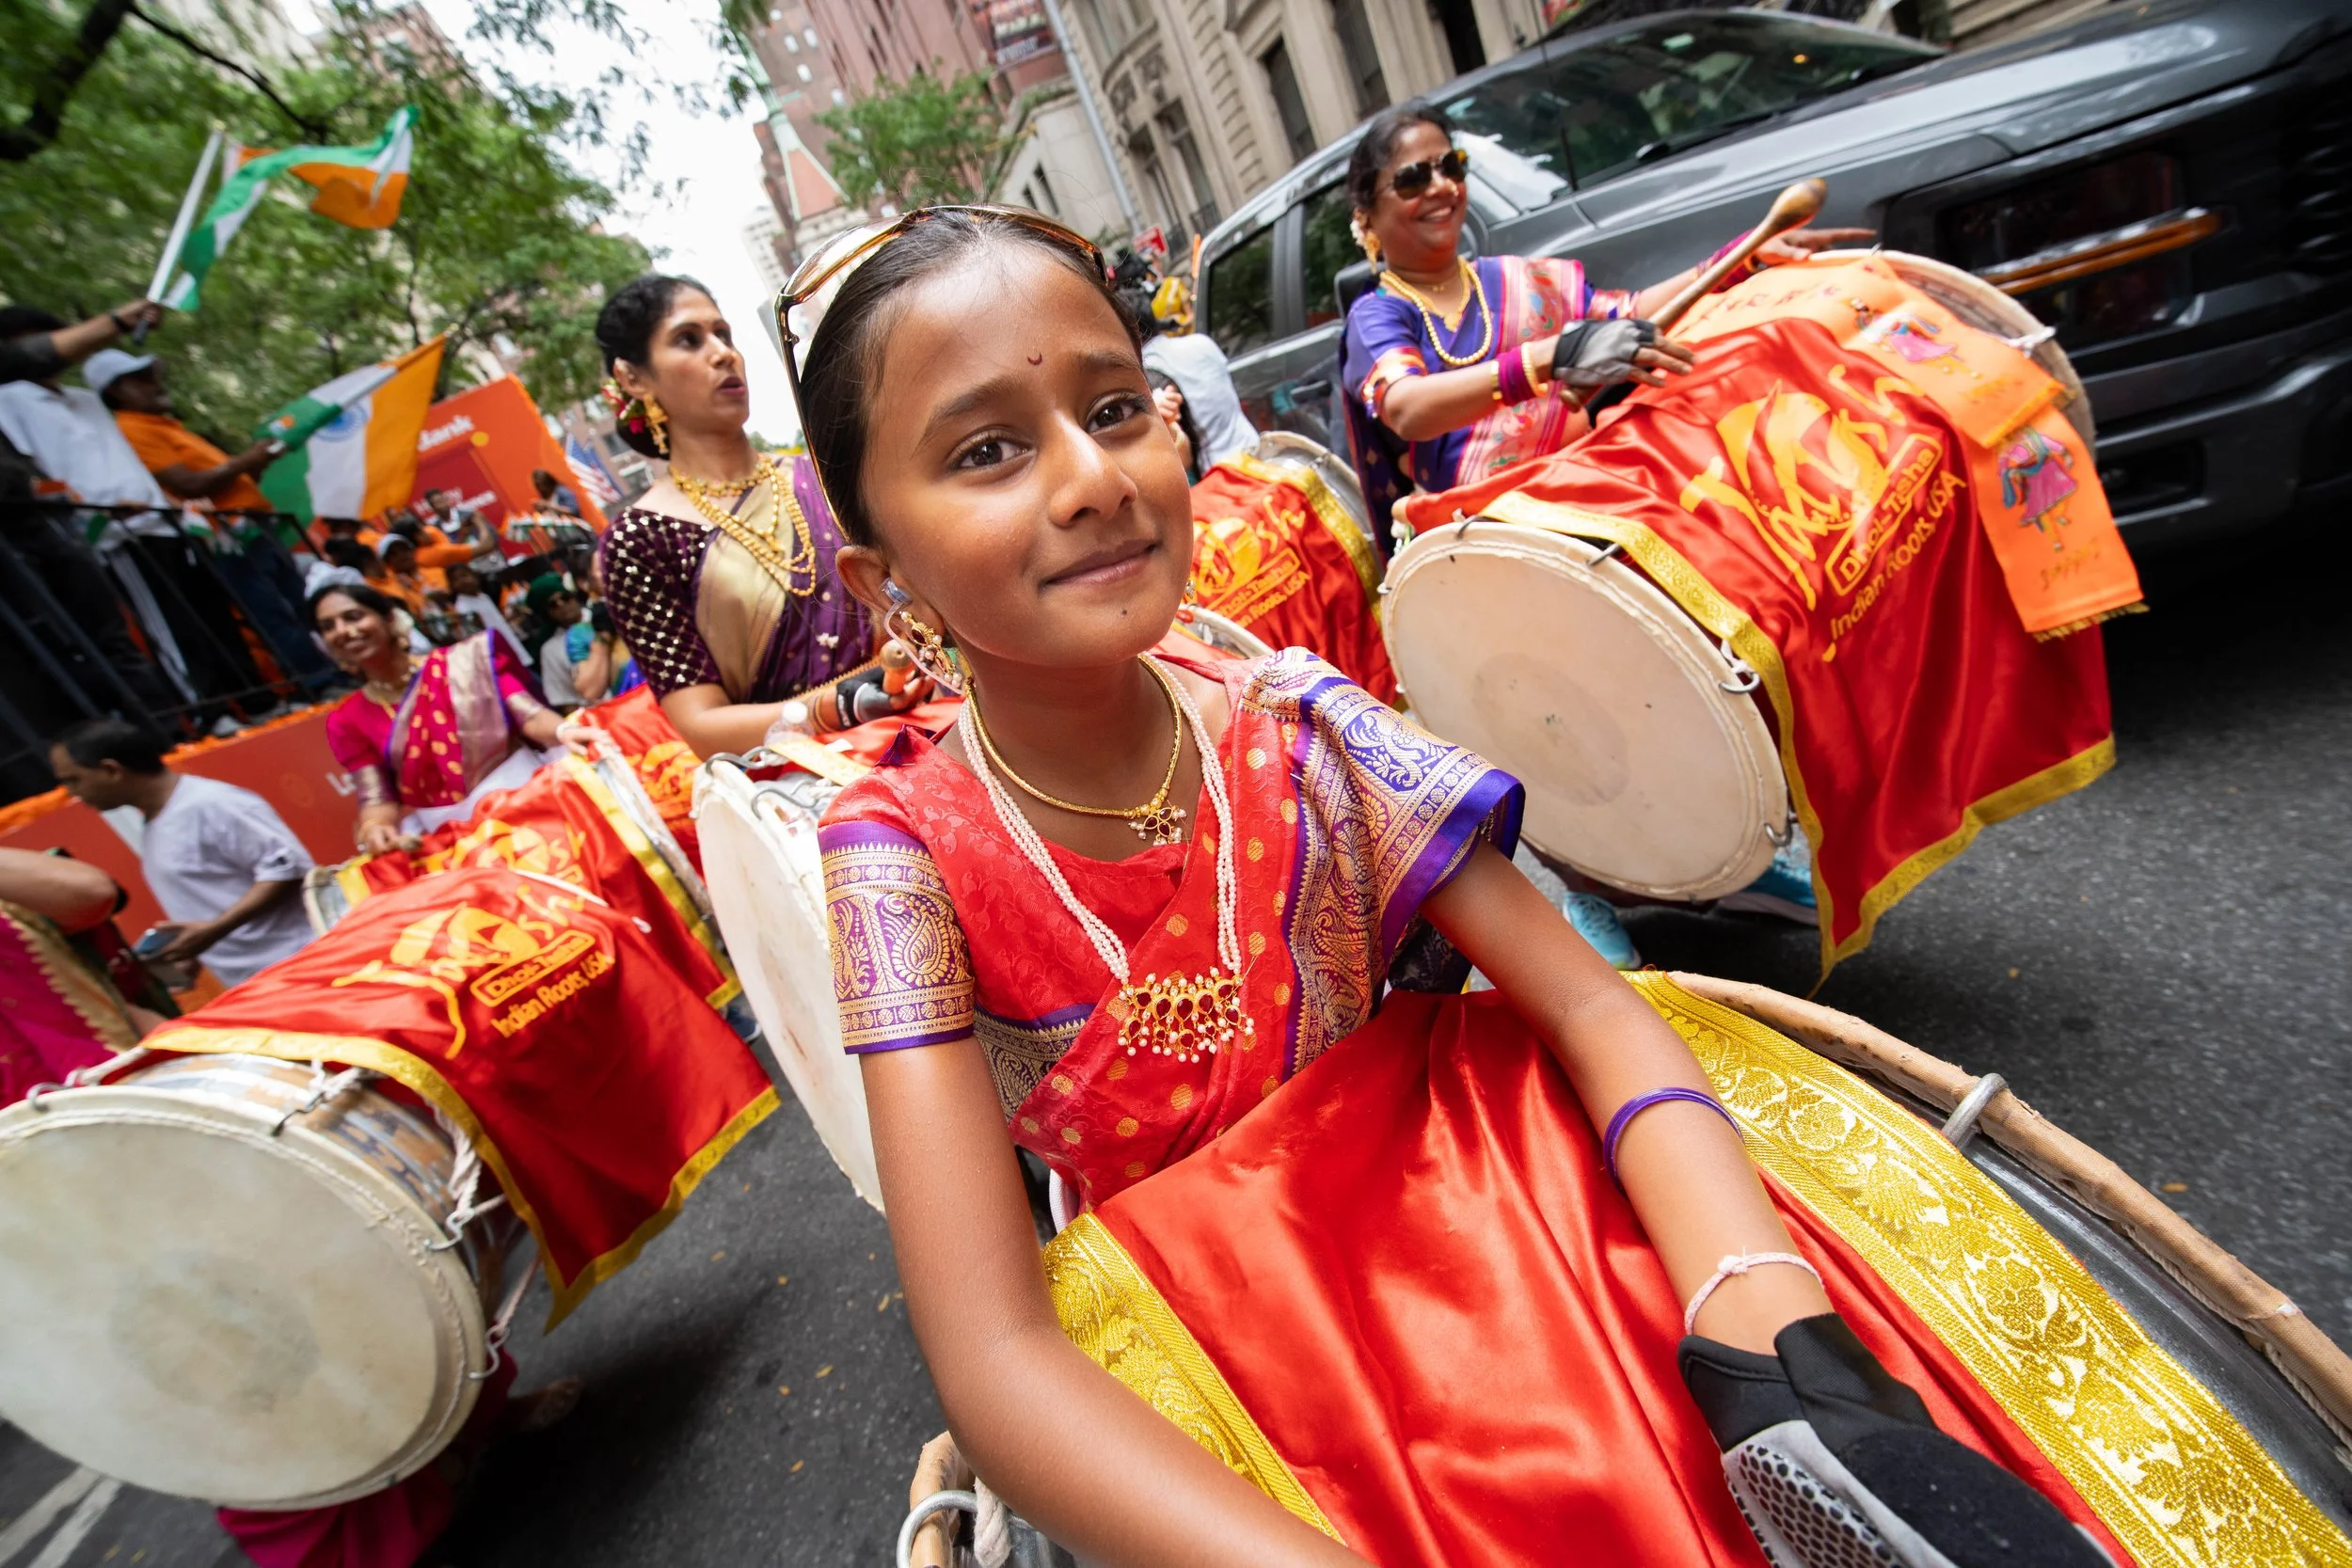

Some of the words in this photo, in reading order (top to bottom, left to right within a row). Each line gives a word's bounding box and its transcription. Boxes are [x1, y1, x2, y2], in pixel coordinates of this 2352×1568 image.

[1219, 560, 1295, 616] hol-Tasha
[1282, 570, 1311, 596] USA
[1831, 573, 1885, 640] Indian
[1927, 469, 1967, 518] USA
[490, 998, 548, 1038] Indian
[580, 950, 614, 980] USA
